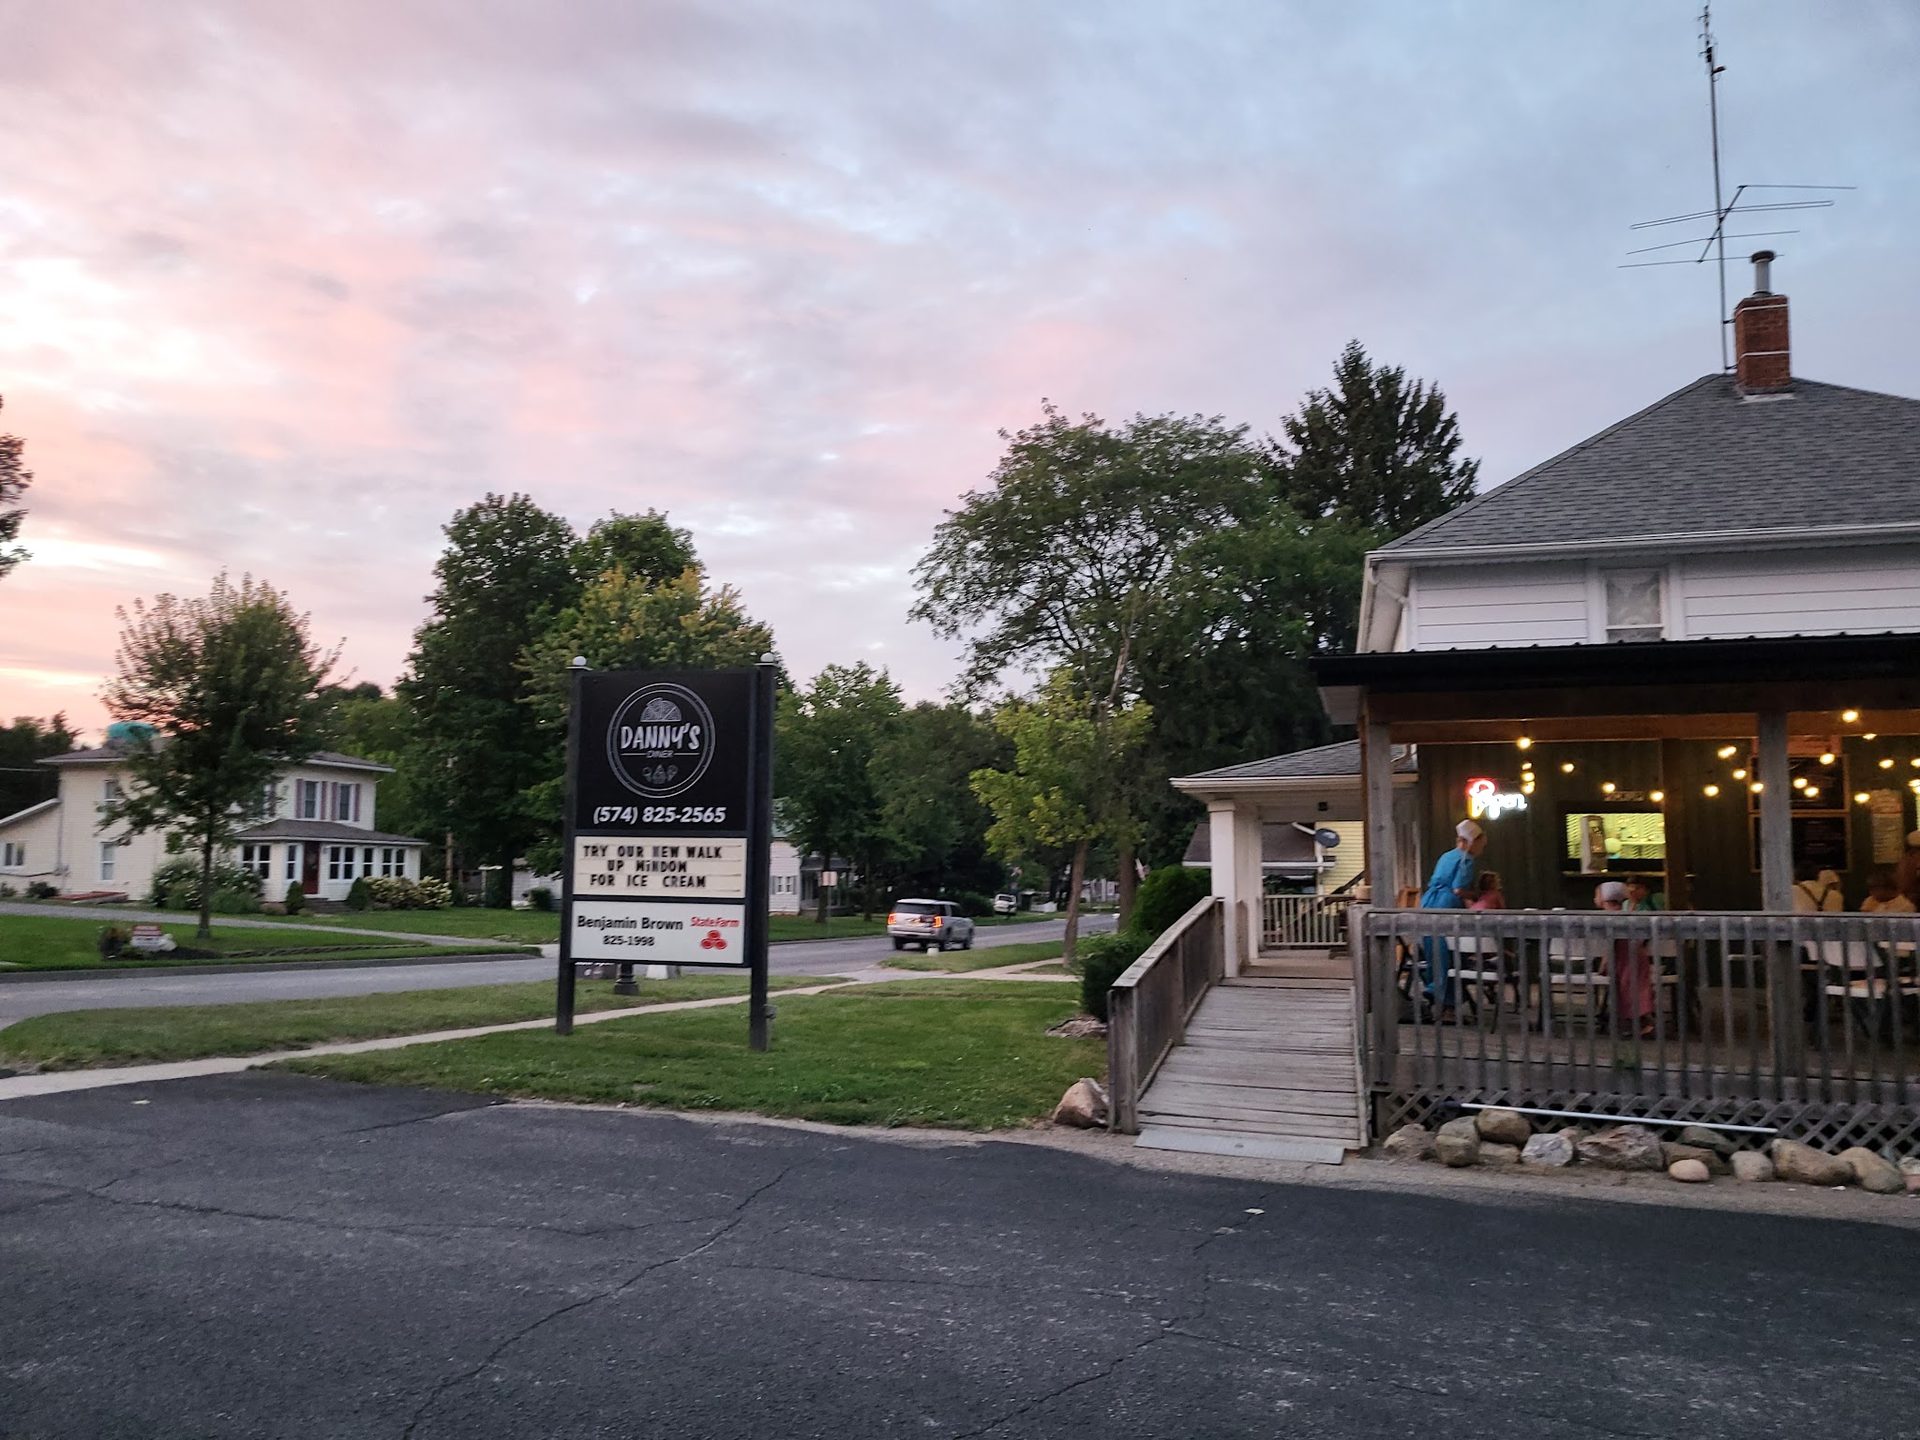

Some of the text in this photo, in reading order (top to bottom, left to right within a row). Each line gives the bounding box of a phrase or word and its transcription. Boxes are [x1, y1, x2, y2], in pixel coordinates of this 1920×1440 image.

[620, 722, 701, 749] DANNY'S
[593, 806, 726, 825] (574) 825-2565
[583, 845, 722, 859] TRY OUR NEW WALK
[607, 860, 624, 871] UP
[590, 874, 706, 888] FOR ICE CREAM
[577, 915, 684, 931] Benjamin Brown
